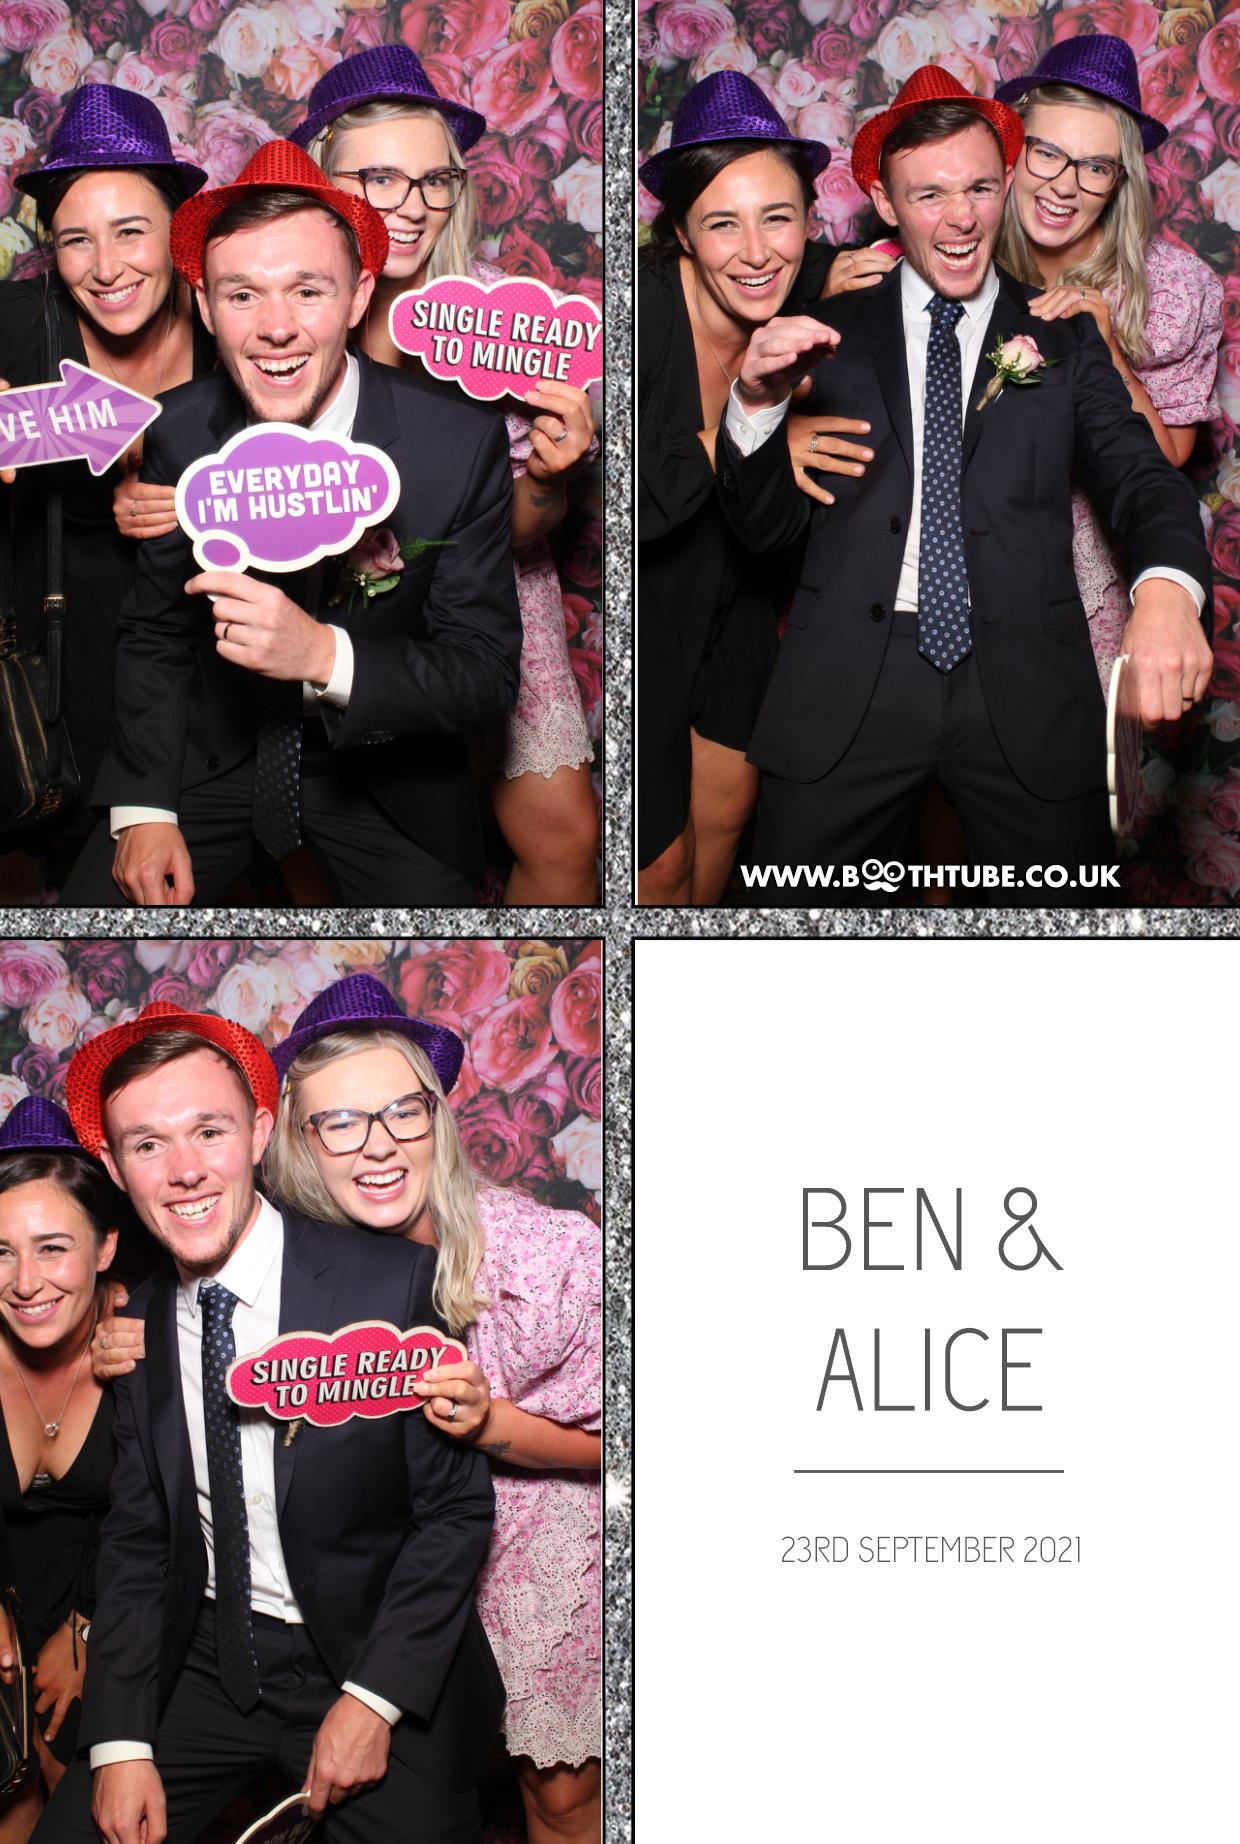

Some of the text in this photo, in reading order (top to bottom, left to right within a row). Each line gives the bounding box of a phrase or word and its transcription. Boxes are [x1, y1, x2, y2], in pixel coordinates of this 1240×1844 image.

[411, 300, 603, 351] SINGLE READY
[432, 335, 572, 381] TO MINGLE
[48, 398, 118, 435] HIM
[209, 459, 361, 496] EVERYDAY
[197, 484, 378, 524] I'M HUSTLIN'
[252, 1346, 447, 1384] SINGLE READY
[276, 1374, 418, 1408] TO MINGLE
